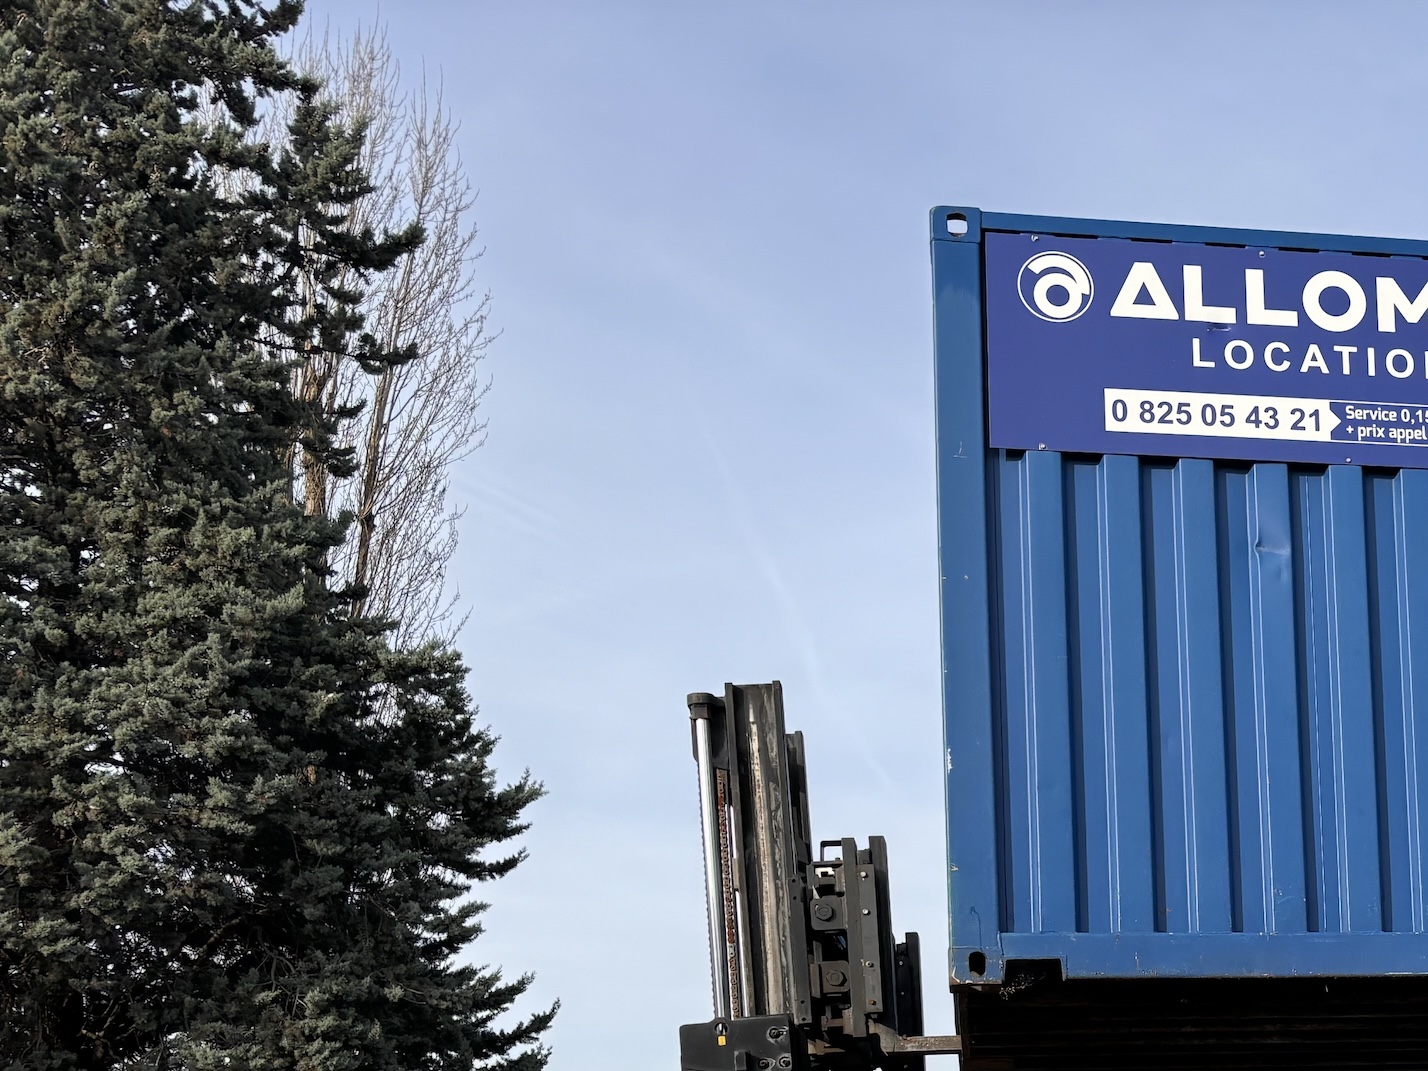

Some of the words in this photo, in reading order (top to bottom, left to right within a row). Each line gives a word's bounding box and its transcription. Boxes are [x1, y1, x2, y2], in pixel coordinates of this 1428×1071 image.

[1111, 398, 1128, 423] 0
[1139, 400, 1192, 426] 825
[1201, 402, 1236, 428] 05
[1245, 405, 1280, 430] 43
[1290, 407, 1321, 432] 21
[1345, 405, 1397, 422] Service
[1346, 425, 1354, 434] +
[1357, 423, 1385, 441] prix
[1389, 425, 1428, 444] appel
